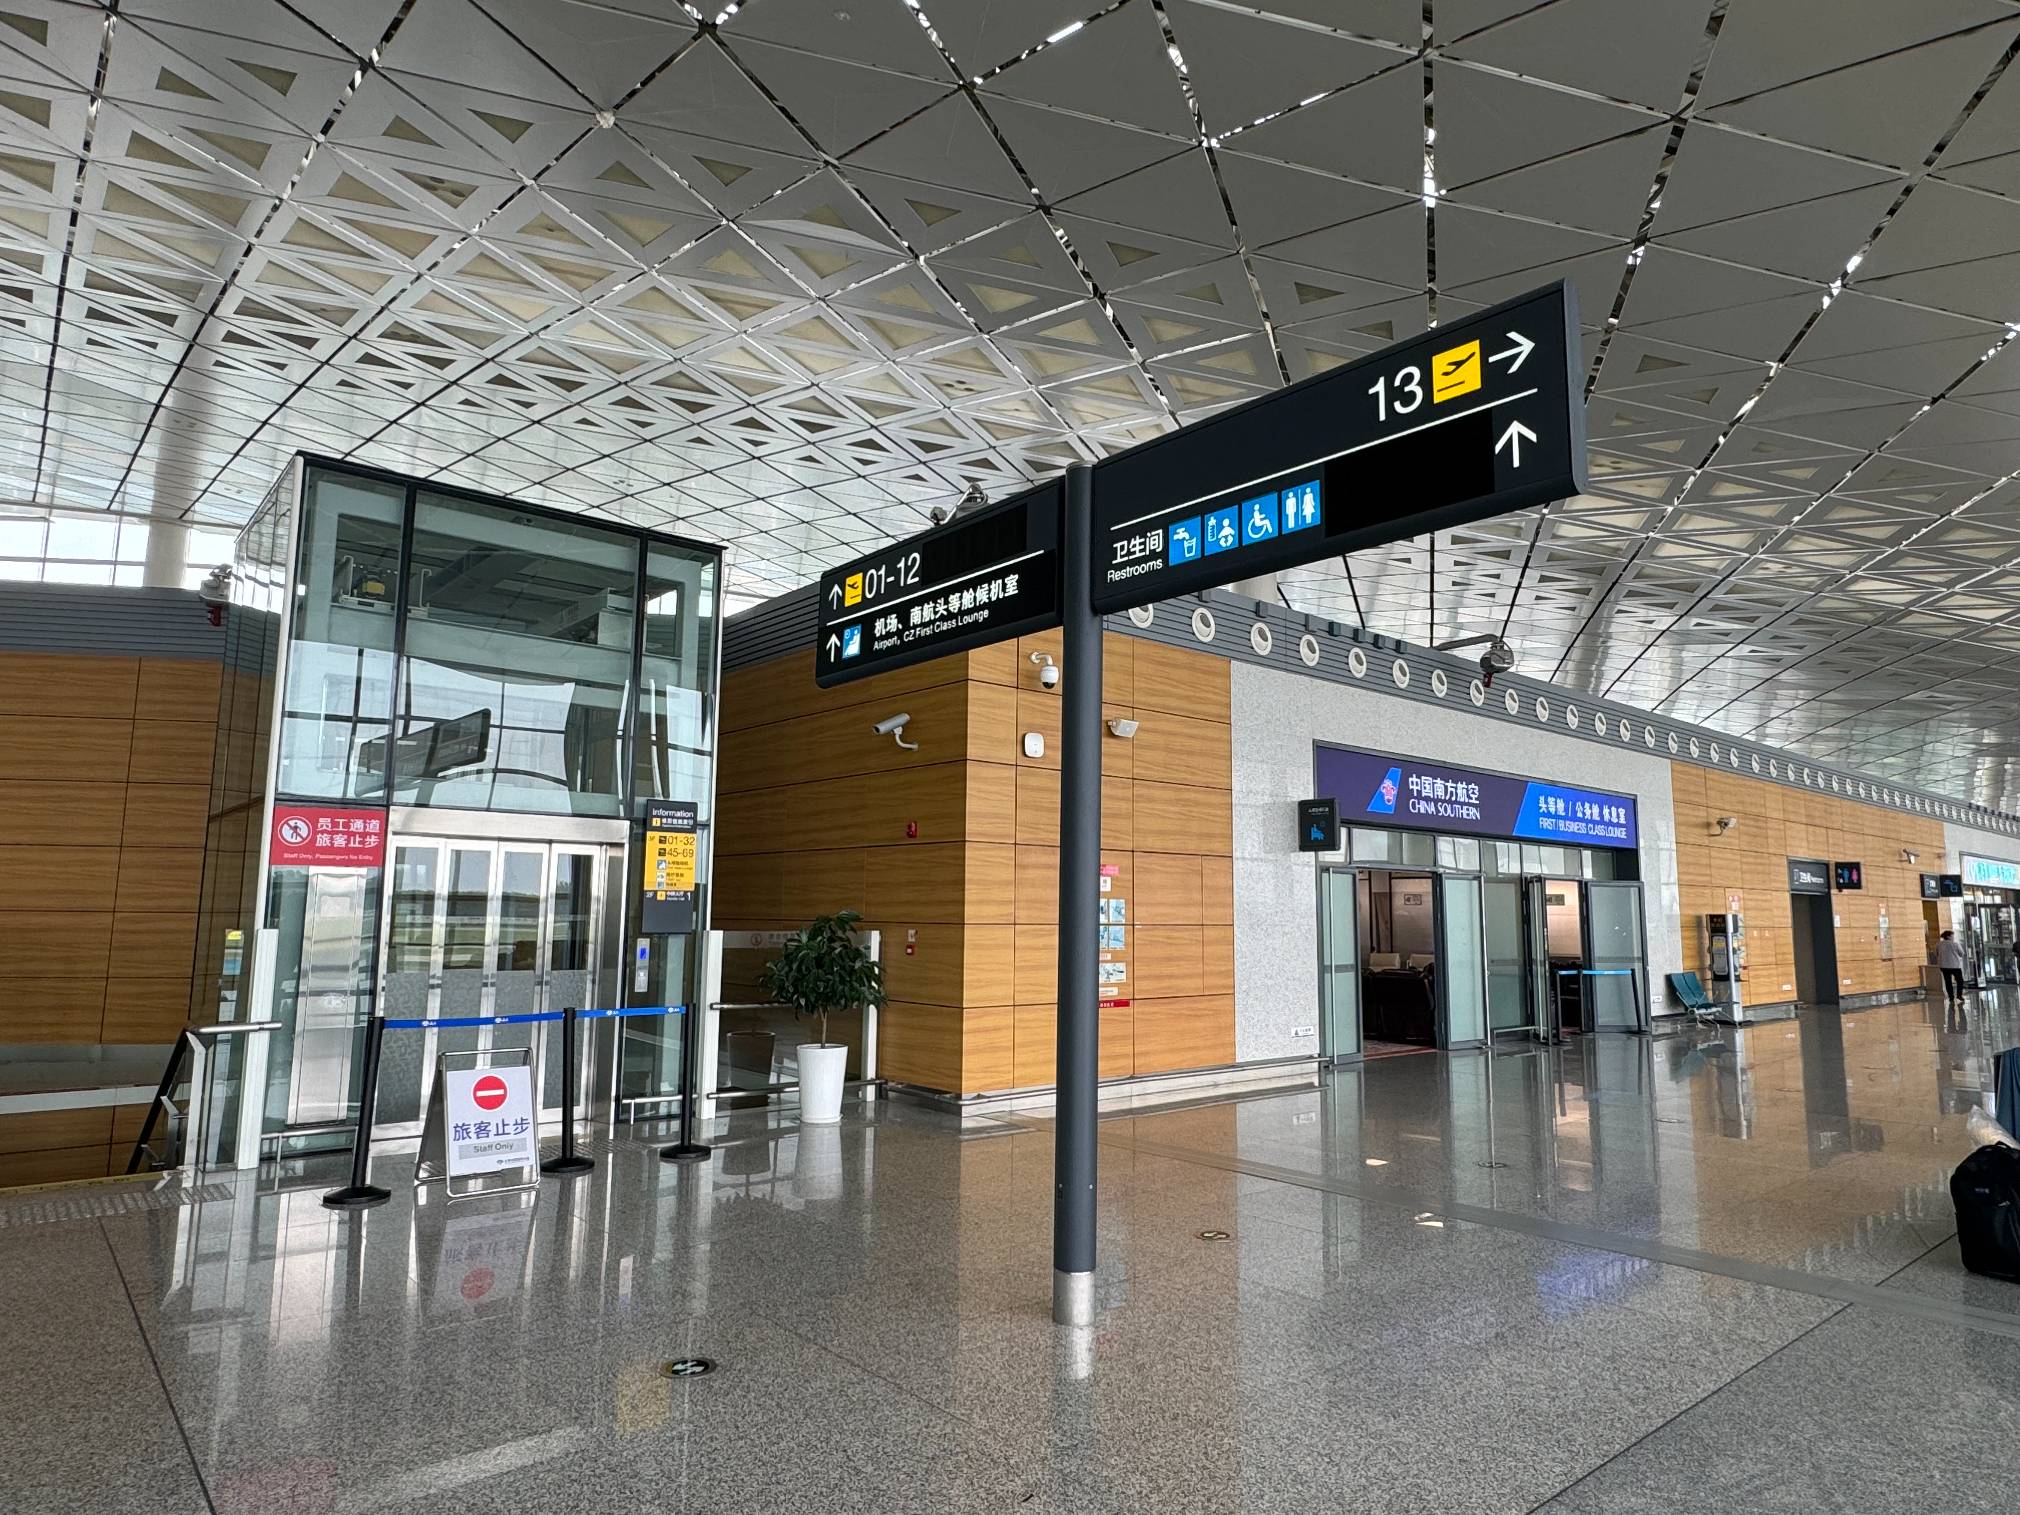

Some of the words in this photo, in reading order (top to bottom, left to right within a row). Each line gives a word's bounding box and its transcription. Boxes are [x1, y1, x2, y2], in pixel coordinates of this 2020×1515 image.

[1368, 366, 1423, 421] 13
[1111, 529, 1163, 564] 卫生间
[865, 552, 921, 599] 01-12
[1107, 558, 1163, 583] Restrooms
[903, 629, 915, 642] CZ
[916, 624, 933, 638] First
[934, 617, 956, 633] Class
[958, 609, 989, 626] Lounge
[1409, 774, 1480, 804] 中国南方航空
[1409, 798, 1436, 815] CHINA
[1438, 801, 1480, 820] SOUTHERN
[1602, 804, 1626, 824] 休息室
[316, 817, 381, 833] 员工通道
[315, 833, 380, 848] 旅客止步
[667, 835, 696, 846] 01-32
[667, 847, 695, 858] 45-69
[453, 1117, 530, 1142] 旅客止步
[473, 1144, 493, 1154] Staff
[495, 1141, 514, 1151] Only
